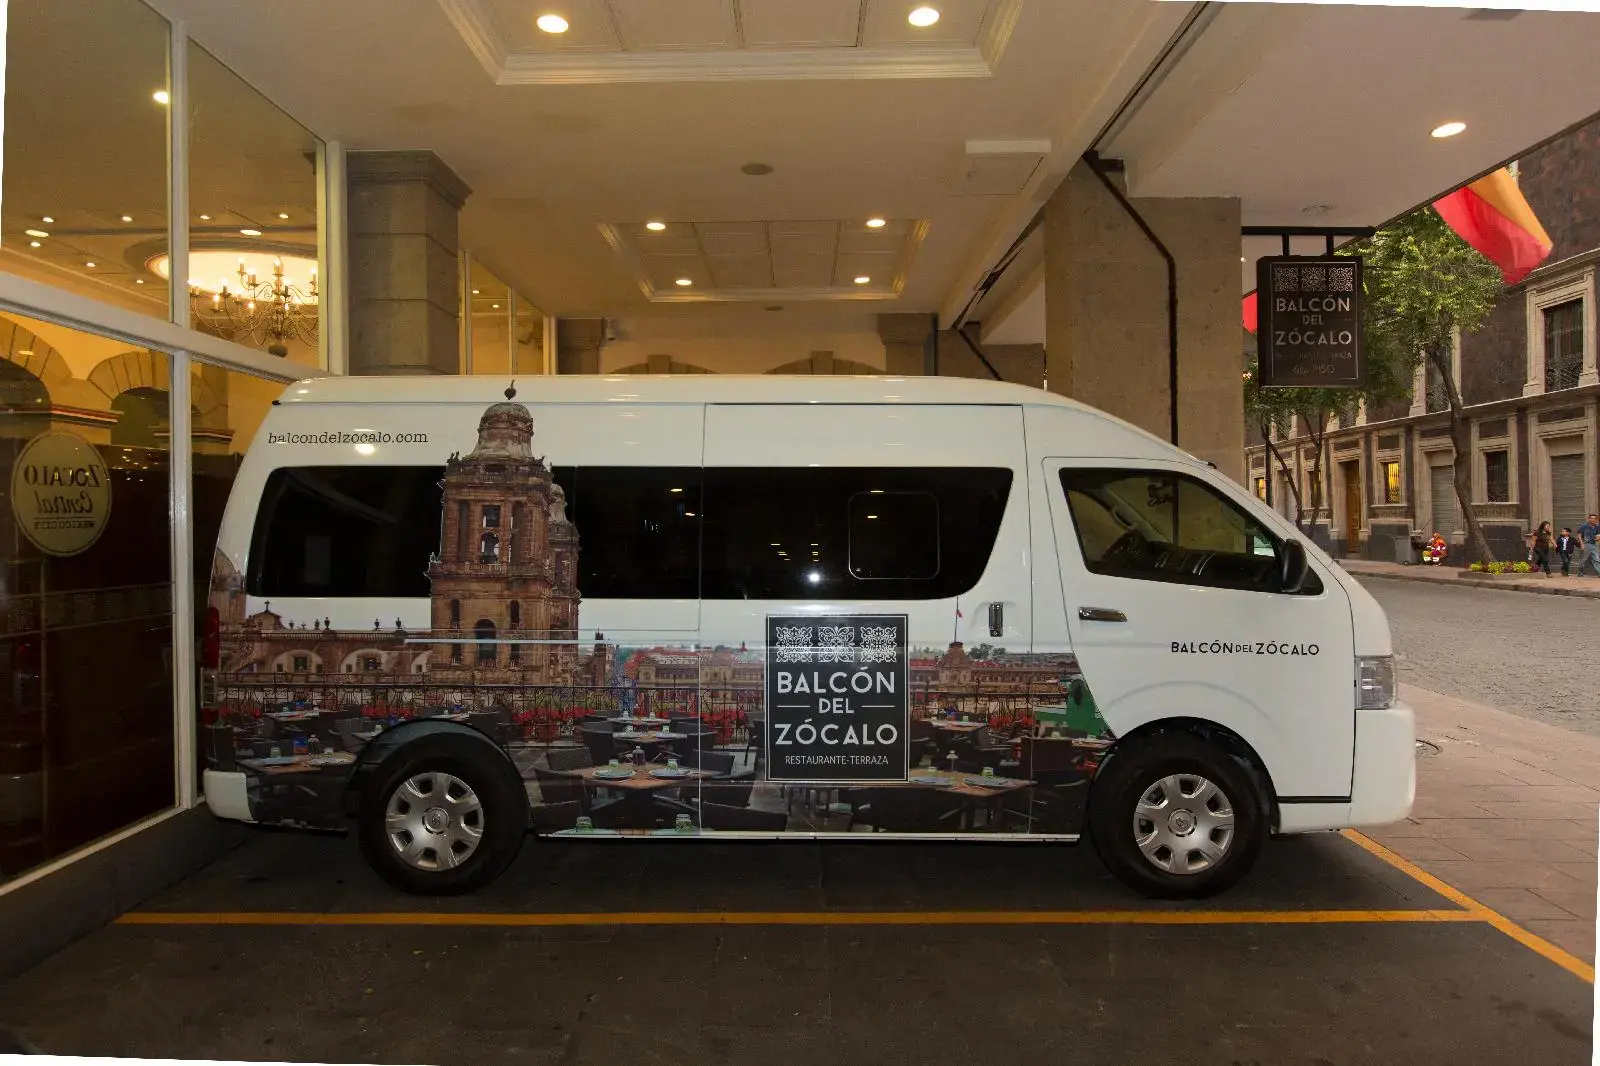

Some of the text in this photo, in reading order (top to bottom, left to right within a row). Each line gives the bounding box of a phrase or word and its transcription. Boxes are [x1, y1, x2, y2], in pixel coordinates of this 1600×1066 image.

[1276, 294, 1350, 312] BALCÓN
[1302, 314, 1325, 325] DEL
[1275, 327, 1352, 345] ZÓCALO
[268, 431, 429, 444] balcondelzocalo.com
[1171, 639, 1320, 656] BALCÓN DEL ZÓCALO
[777, 666, 895, 694] BALCÓN
[818, 697, 855, 714] DEL
[774, 718, 898, 745] ZÓCALO
[785, 755, 889, 765] RESTAURANTE-TERRAZA
